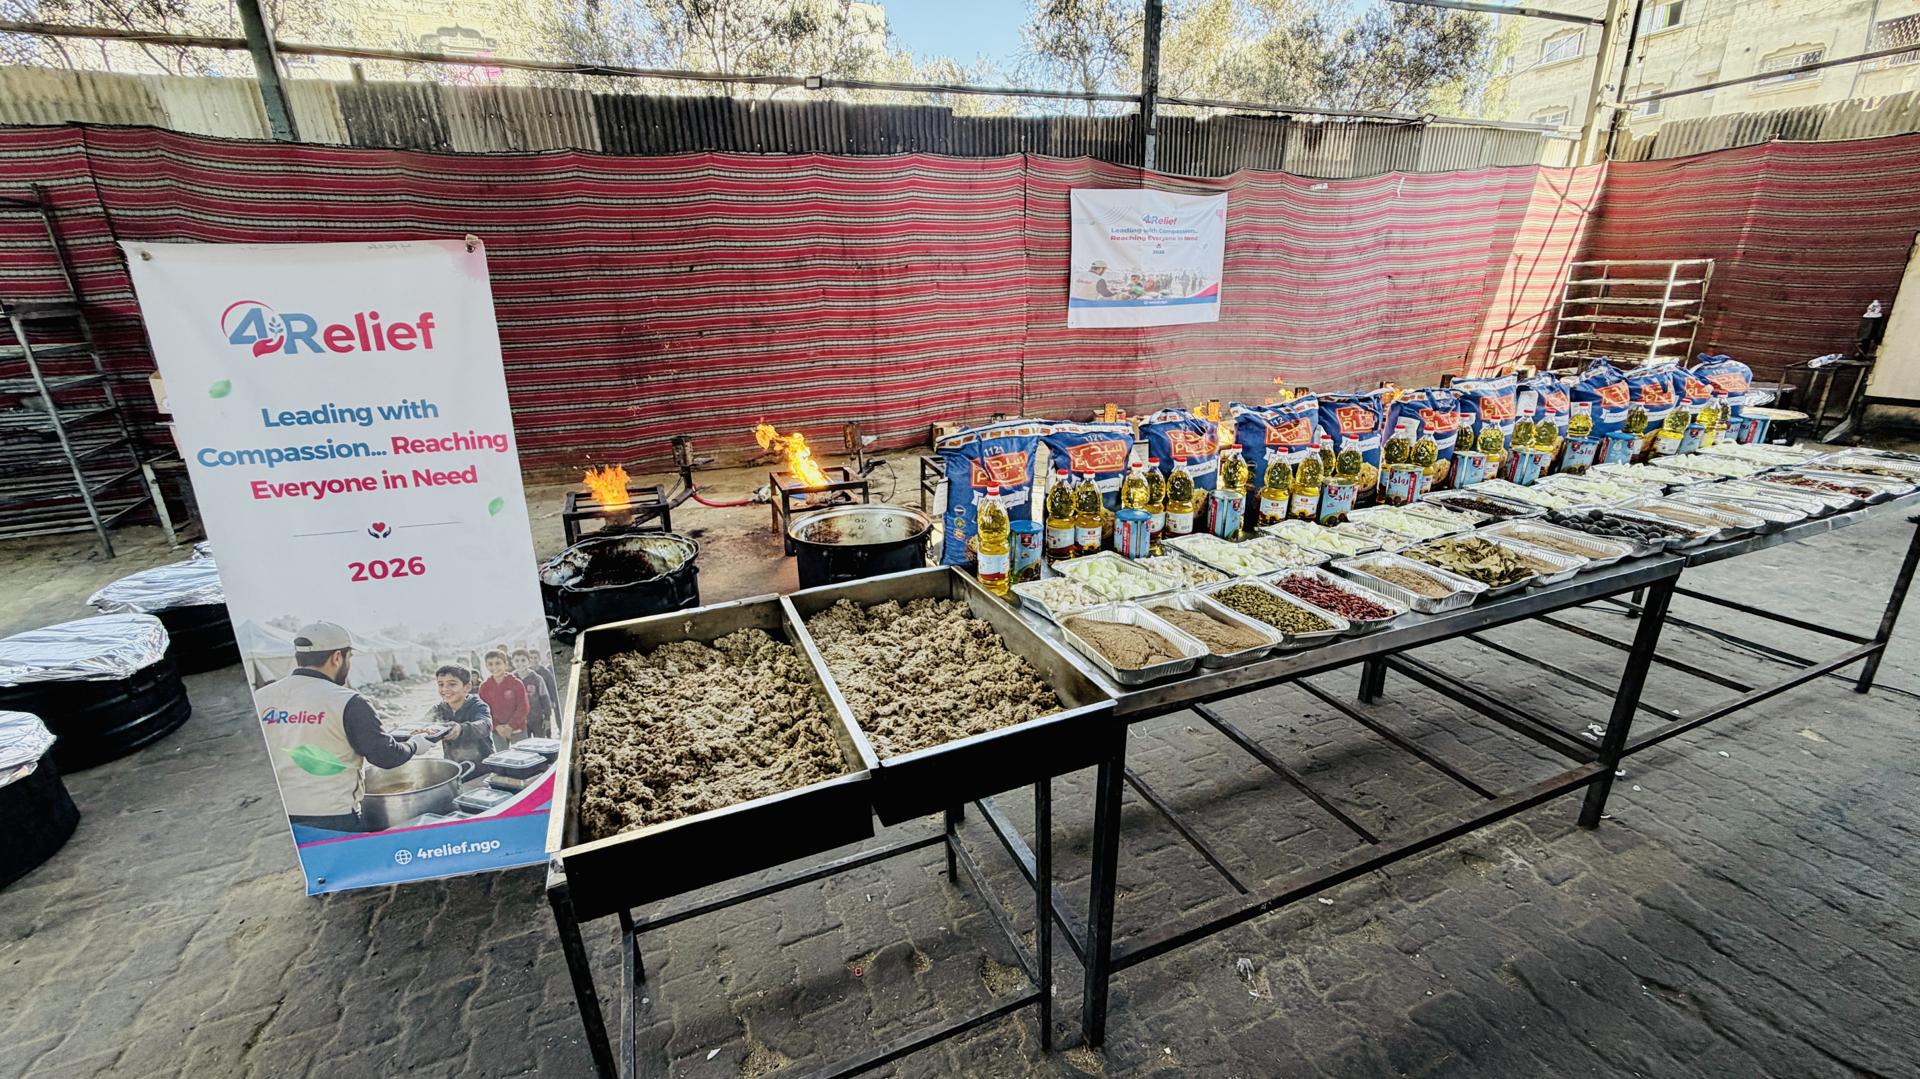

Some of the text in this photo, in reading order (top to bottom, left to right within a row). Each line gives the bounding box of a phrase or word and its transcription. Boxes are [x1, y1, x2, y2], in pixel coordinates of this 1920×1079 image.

[222, 302, 436, 357] 4Relief
[261, 399, 439, 428] Leading with
[197, 430, 508, 469] Compassion... Reaching
[250, 465, 478, 500] Everyone in Need
[347, 556, 427, 582] 2026
[262, 708, 325, 725] 4Relief
[417, 838, 501, 860] 4relief.ngo
